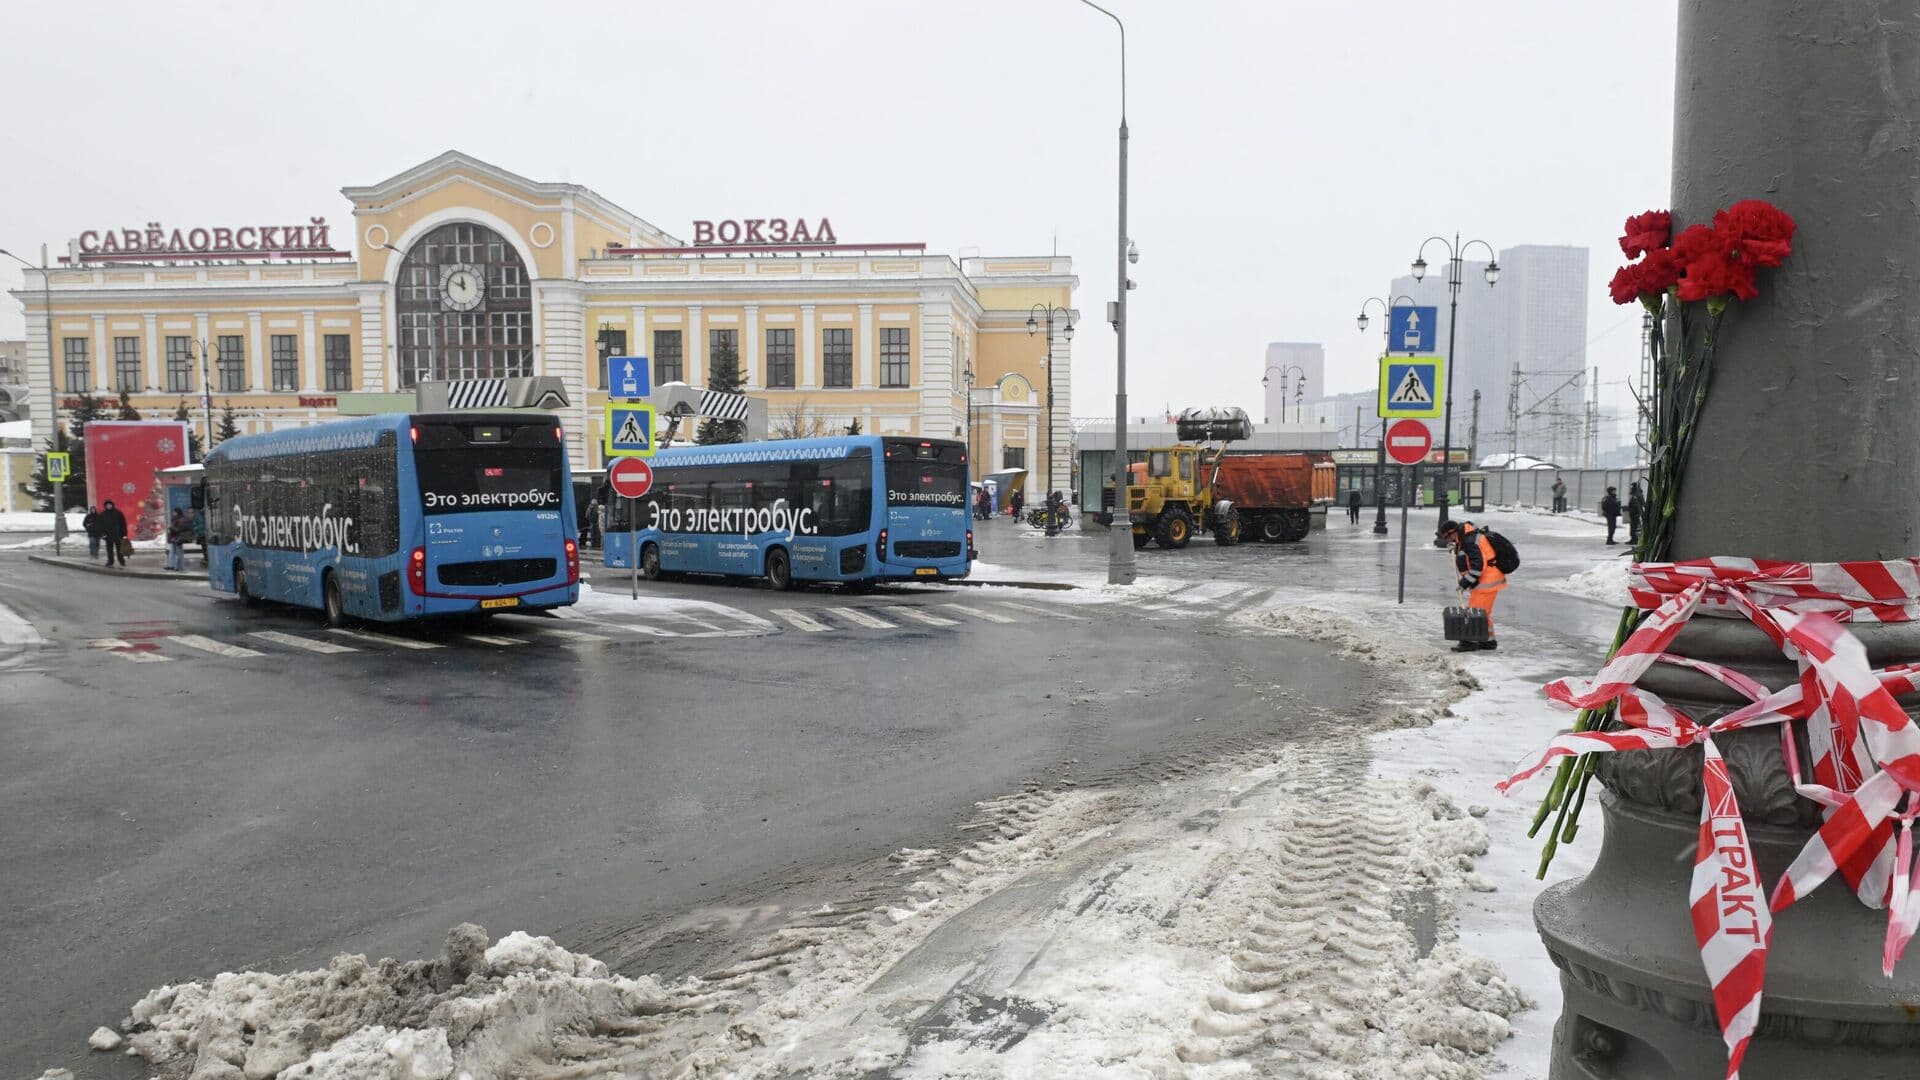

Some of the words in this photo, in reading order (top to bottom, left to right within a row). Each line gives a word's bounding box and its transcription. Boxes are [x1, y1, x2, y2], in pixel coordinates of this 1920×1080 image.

[79, 217, 330, 252] САВЁЛОВСКИЙ
[692, 217, 837, 244] ВОКЗАЛ
[424, 491, 457, 507] Это
[461, 488, 560, 506] электробус.
[888, 489, 907, 501] Это
[909, 491, 964, 504] электробус.
[234, 504, 258, 546] Это
[261, 503, 359, 564] электробус.
[647, 499, 681, 533] Это
[686, 497, 818, 542] электробус.
[1713, 822, 1762, 944] ТРАКТ
